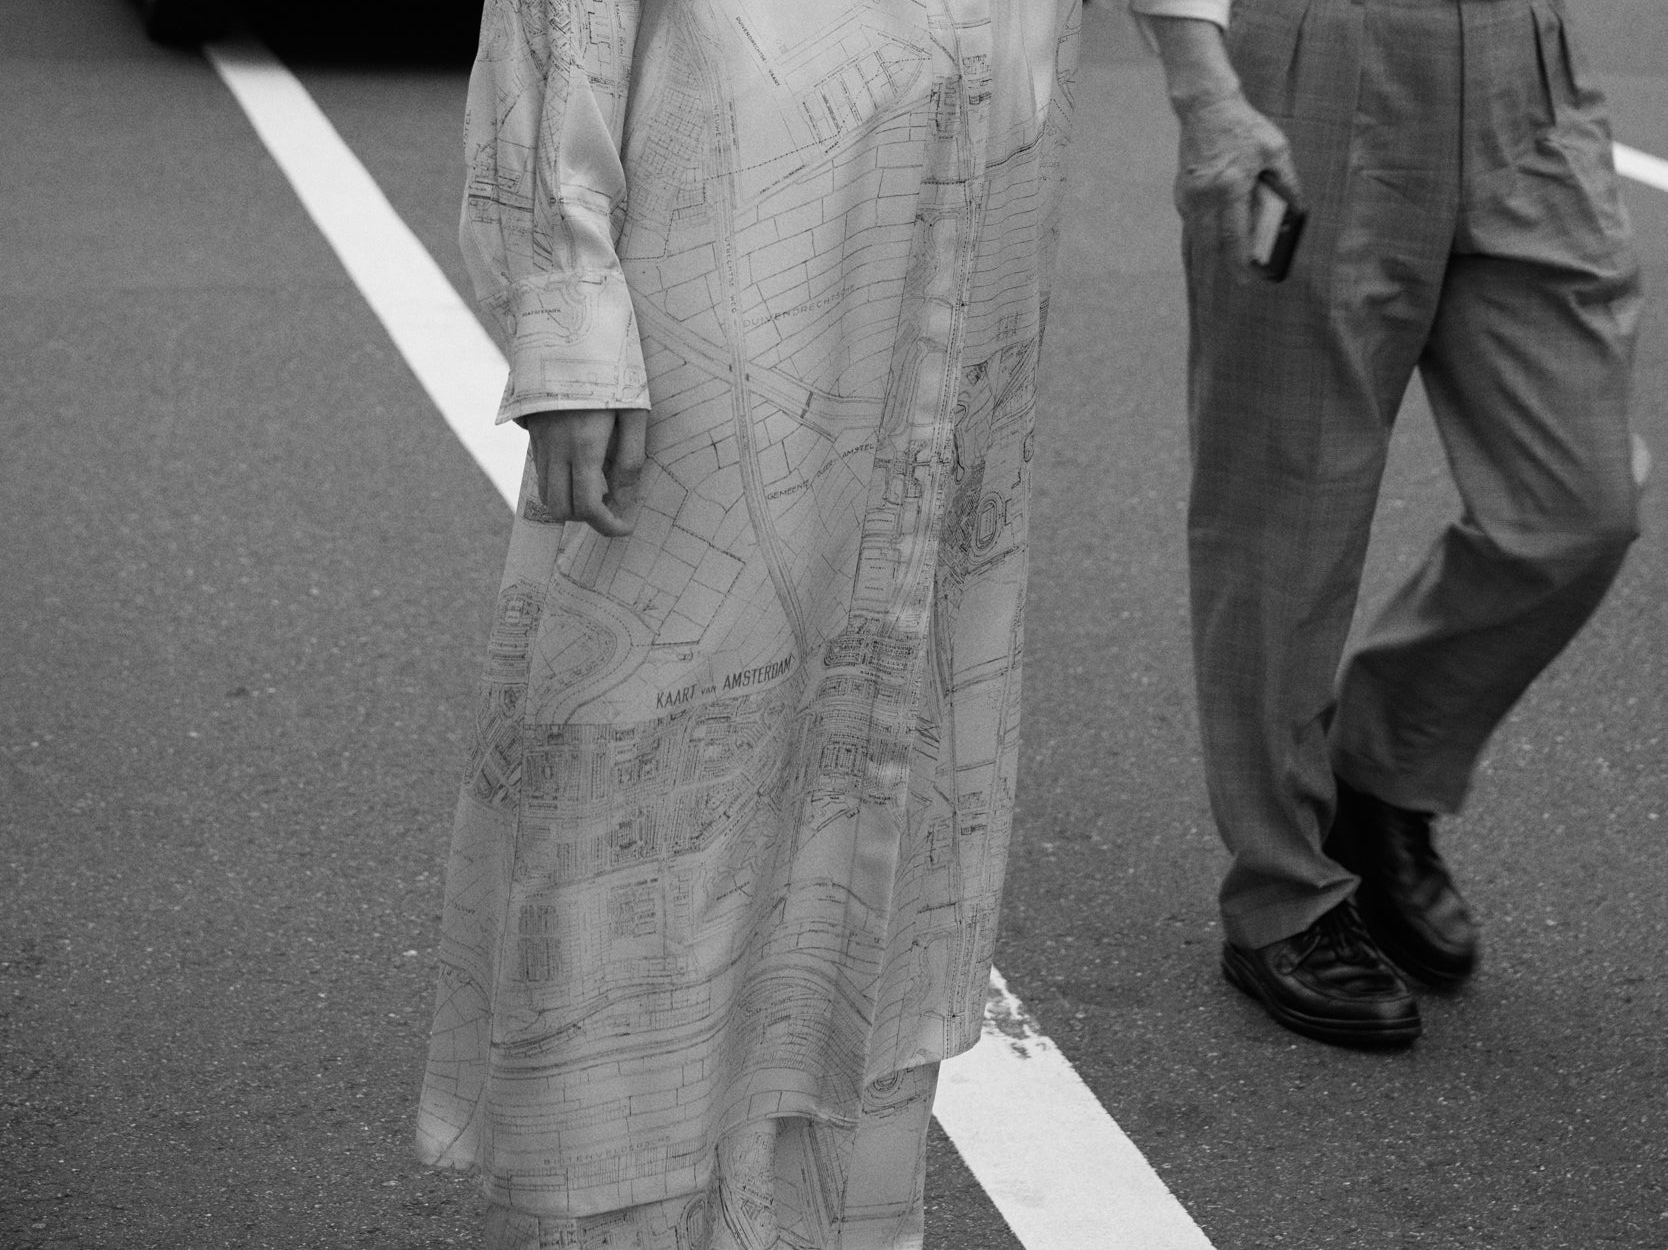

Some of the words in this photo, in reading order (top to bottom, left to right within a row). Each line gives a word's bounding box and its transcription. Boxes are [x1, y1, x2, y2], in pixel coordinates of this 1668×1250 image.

[767, 479, 811, 500] GEMEENTE
[841, 443, 875, 458] AMSTEL
[656, 683, 698, 710] KAART
[722, 652, 796, 691] AMSTERDAM
